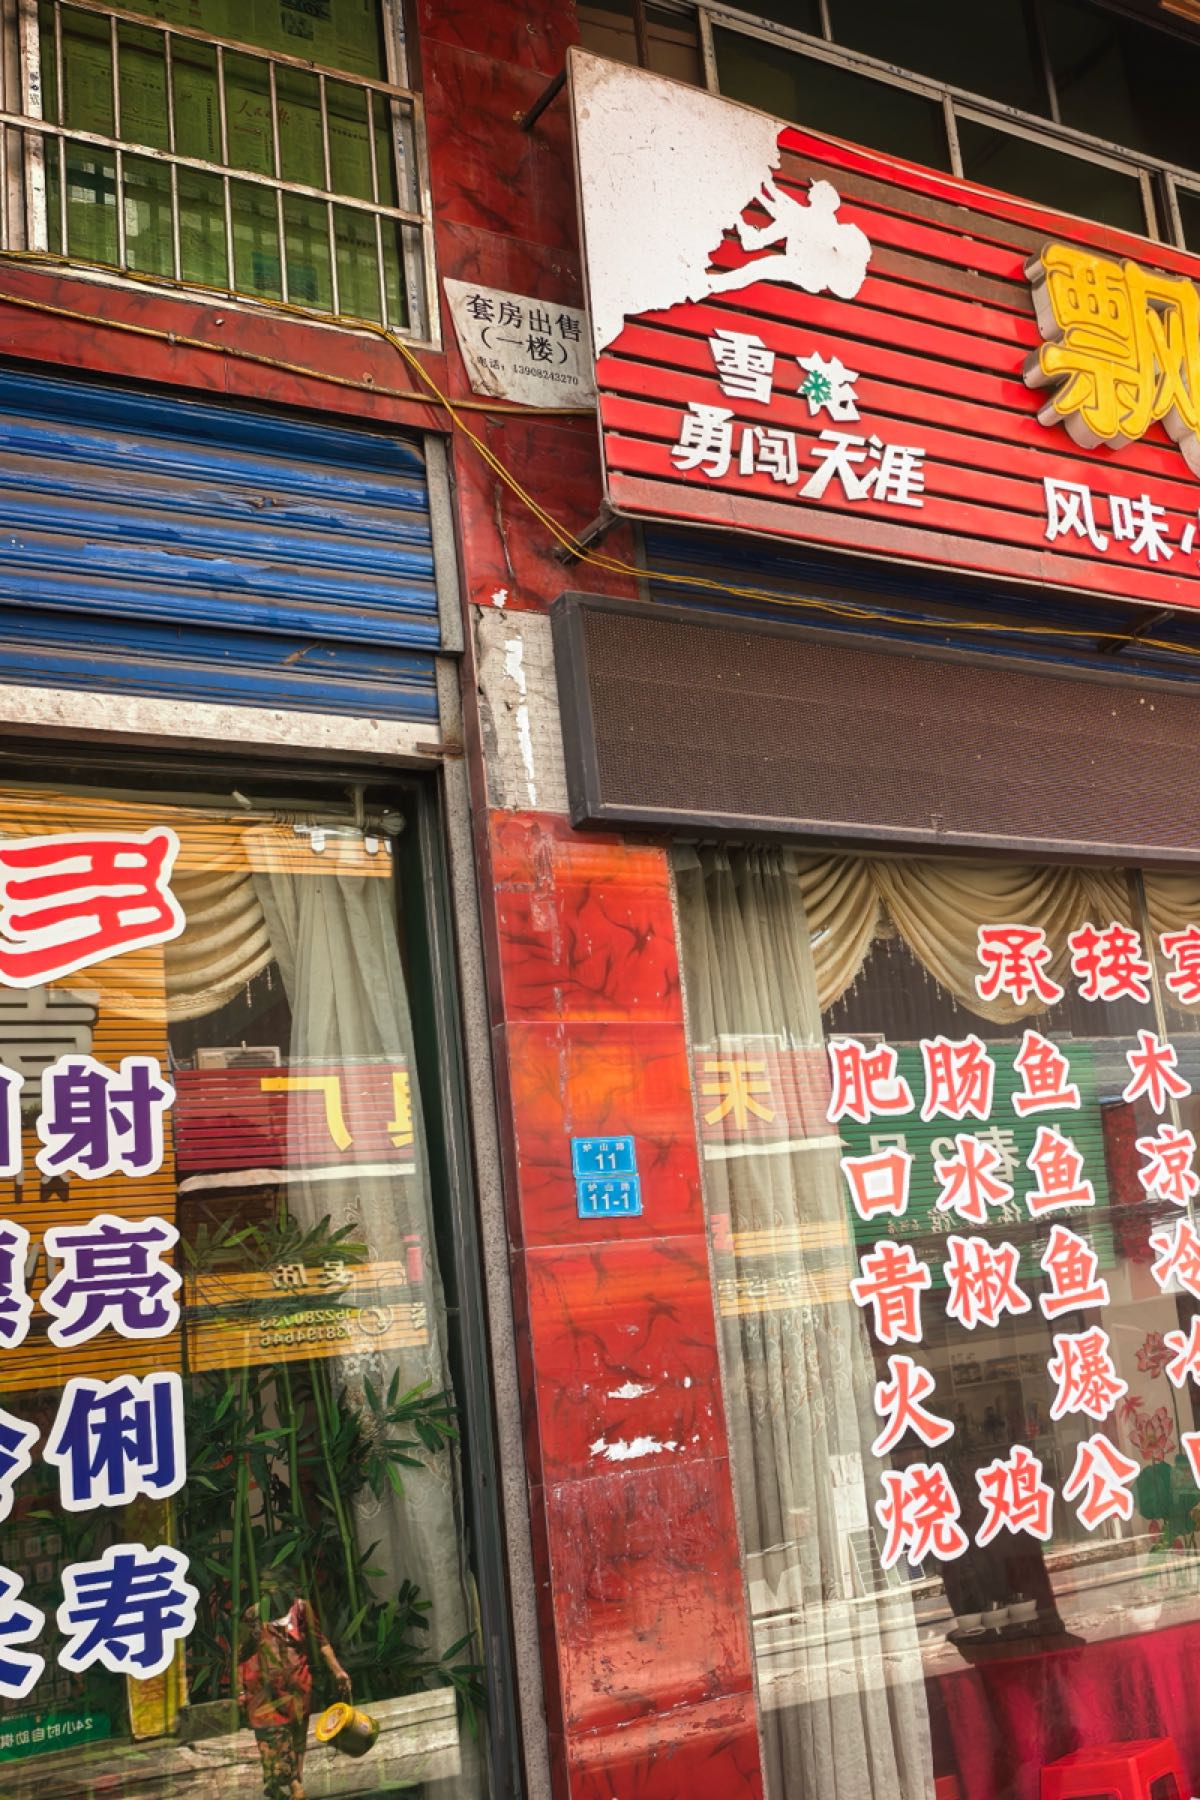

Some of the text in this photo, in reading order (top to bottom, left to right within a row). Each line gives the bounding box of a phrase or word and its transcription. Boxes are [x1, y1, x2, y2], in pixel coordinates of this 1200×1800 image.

[466, 294, 582, 342] 套房出售
[709, 328, 860, 422] 雪花
[672, 403, 925, 507] 勇闯天涯
[0, 1062, 170, 1175] 射
[828, 1030, 1081, 1122] 肥肠鱼
[589, 1193, 629, 1210] 11-1
[595, 1152, 616, 1170] 11
[841, 1127, 1095, 1220] 口水鱼
[852, 1223, 1109, 1345] 青椒鱼
[876, 1432, 1139, 1570] 烧鸡公
